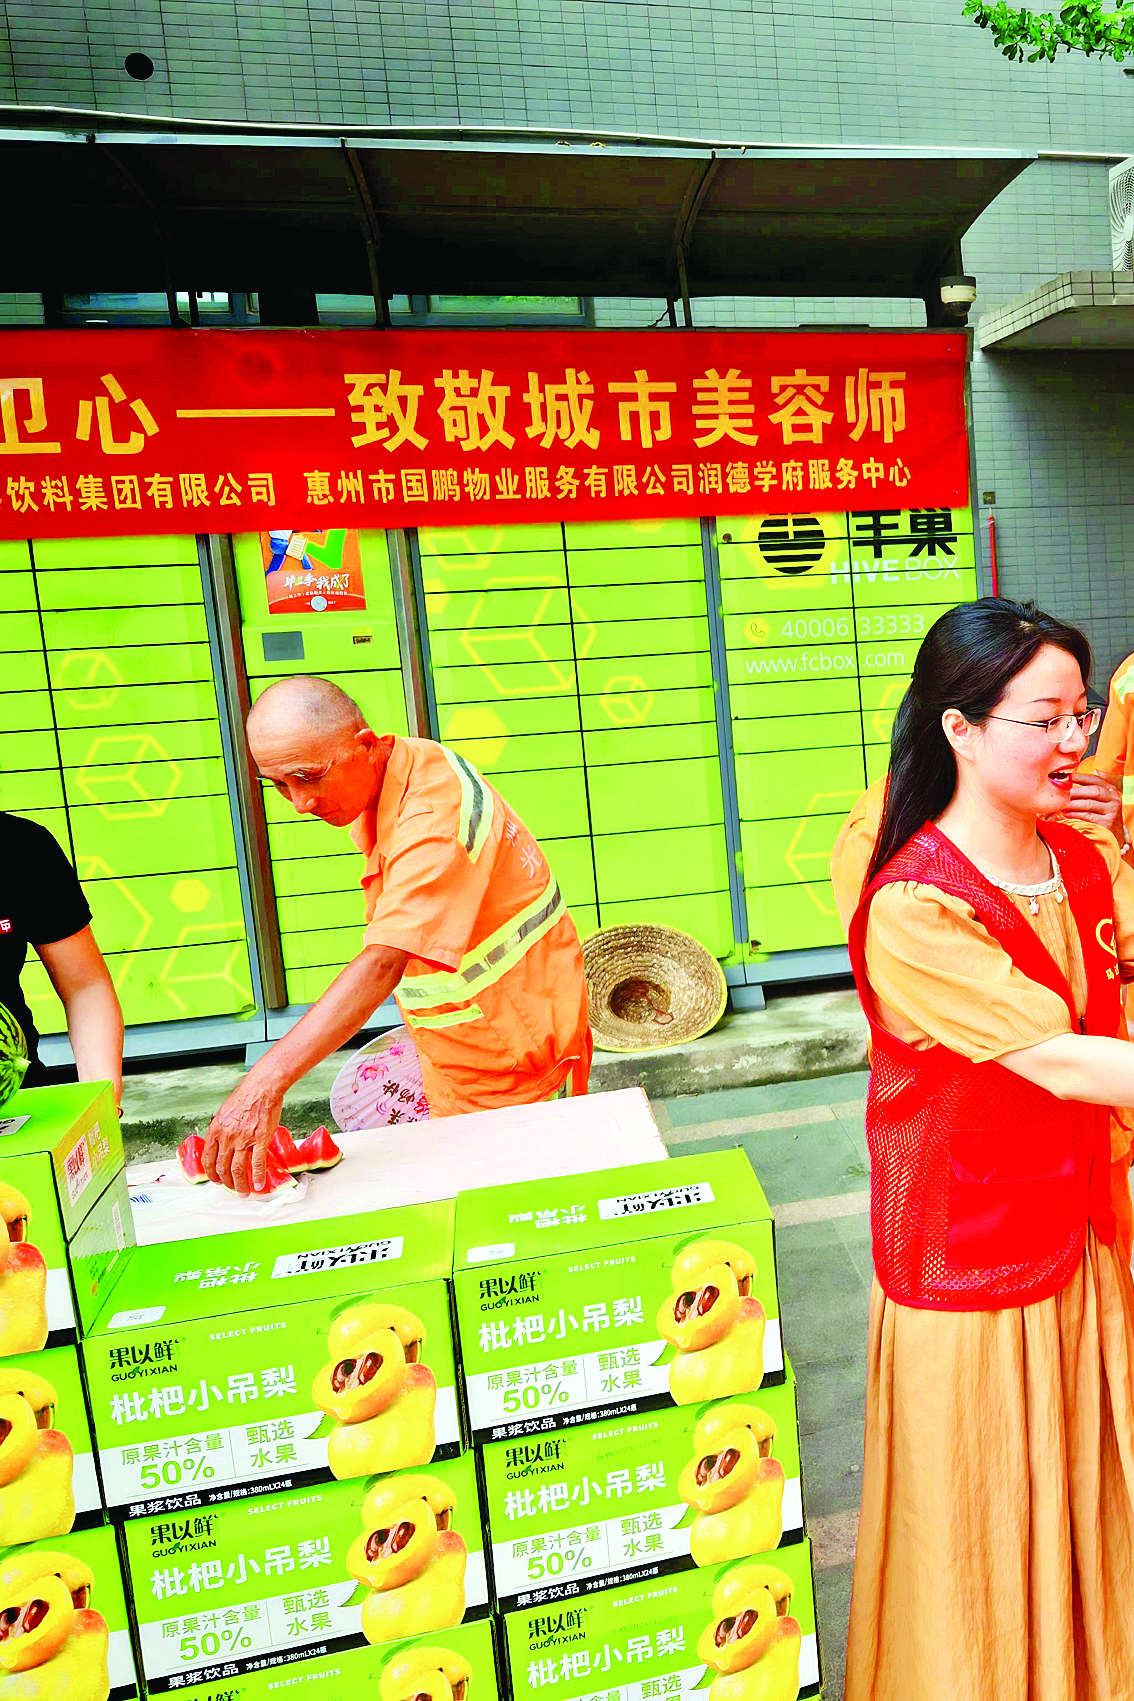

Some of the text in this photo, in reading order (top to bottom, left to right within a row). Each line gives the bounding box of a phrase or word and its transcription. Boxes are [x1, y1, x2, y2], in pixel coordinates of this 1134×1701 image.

[303, 456, 912, 506] 惠州市国鹏物业服务有限公司润德学府服务中心
[830, 556, 960, 584] HIVE BOX
[568, 1256, 636, 1272] SELECT FRUITS
[479, 1271, 541, 1299] 果以鲜
[209, 1322, 287, 1340] SELECT FRUITS
[478, 1296, 645, 1353] 枇杷小吊梨
[110, 1339, 179, 1369] 果以鲜
[598, 1348, 641, 1371] 甄选
[487, 1360, 578, 1391] 原果汁含量
[601, 1370, 642, 1393] 水果
[110, 1365, 297, 1425] 枇杷小吊梨
[503, 1381, 569, 1413] 50%
[246, 1420, 294, 1445] 甄选
[491, 1418, 557, 1439] 果浆饮品
[592, 1422, 659, 1440] SELECT FRUITS
[122, 1433, 224, 1465] 原果汁含量
[251, 1443, 297, 1469] 水果
[506, 1439, 566, 1468] 果以鲜
[140, 1456, 215, 1489] 50%
[248, 1495, 322, 1515] SELECT FRUITS
[504, 1461, 666, 1521] 枇杷小吊梨
[129, 1494, 201, 1517] 果浆饮品
[151, 1515, 218, 1545] 果以鲜
[621, 1512, 662, 1536] 甄选
[512, 1526, 601, 1558] 原果汁含量
[623, 1533, 663, 1557] 水果
[151, 1537, 333, 1600] 枇杷小吊梨
[527, 1547, 592, 1580] 50%
[283, 1590, 329, 1615] 甄选
[517, 1583, 579, 1607] 果浆饮品
[613, 1587, 678, 1607] SELECT FRUITS
[162, 1604, 261, 1638] 原果汁含量
[287, 1613, 332, 1636] 水果
[529, 1608, 587, 1639] 果以鲜
[180, 1627, 252, 1661] 50%
[527, 1626, 686, 1689] 枇杷小吊梨
[168, 1664, 239, 1688] 果浆饮品
[268, 1669, 341, 1689] SELECT FRUITS
[641, 1674, 682, 1699] 甄选
